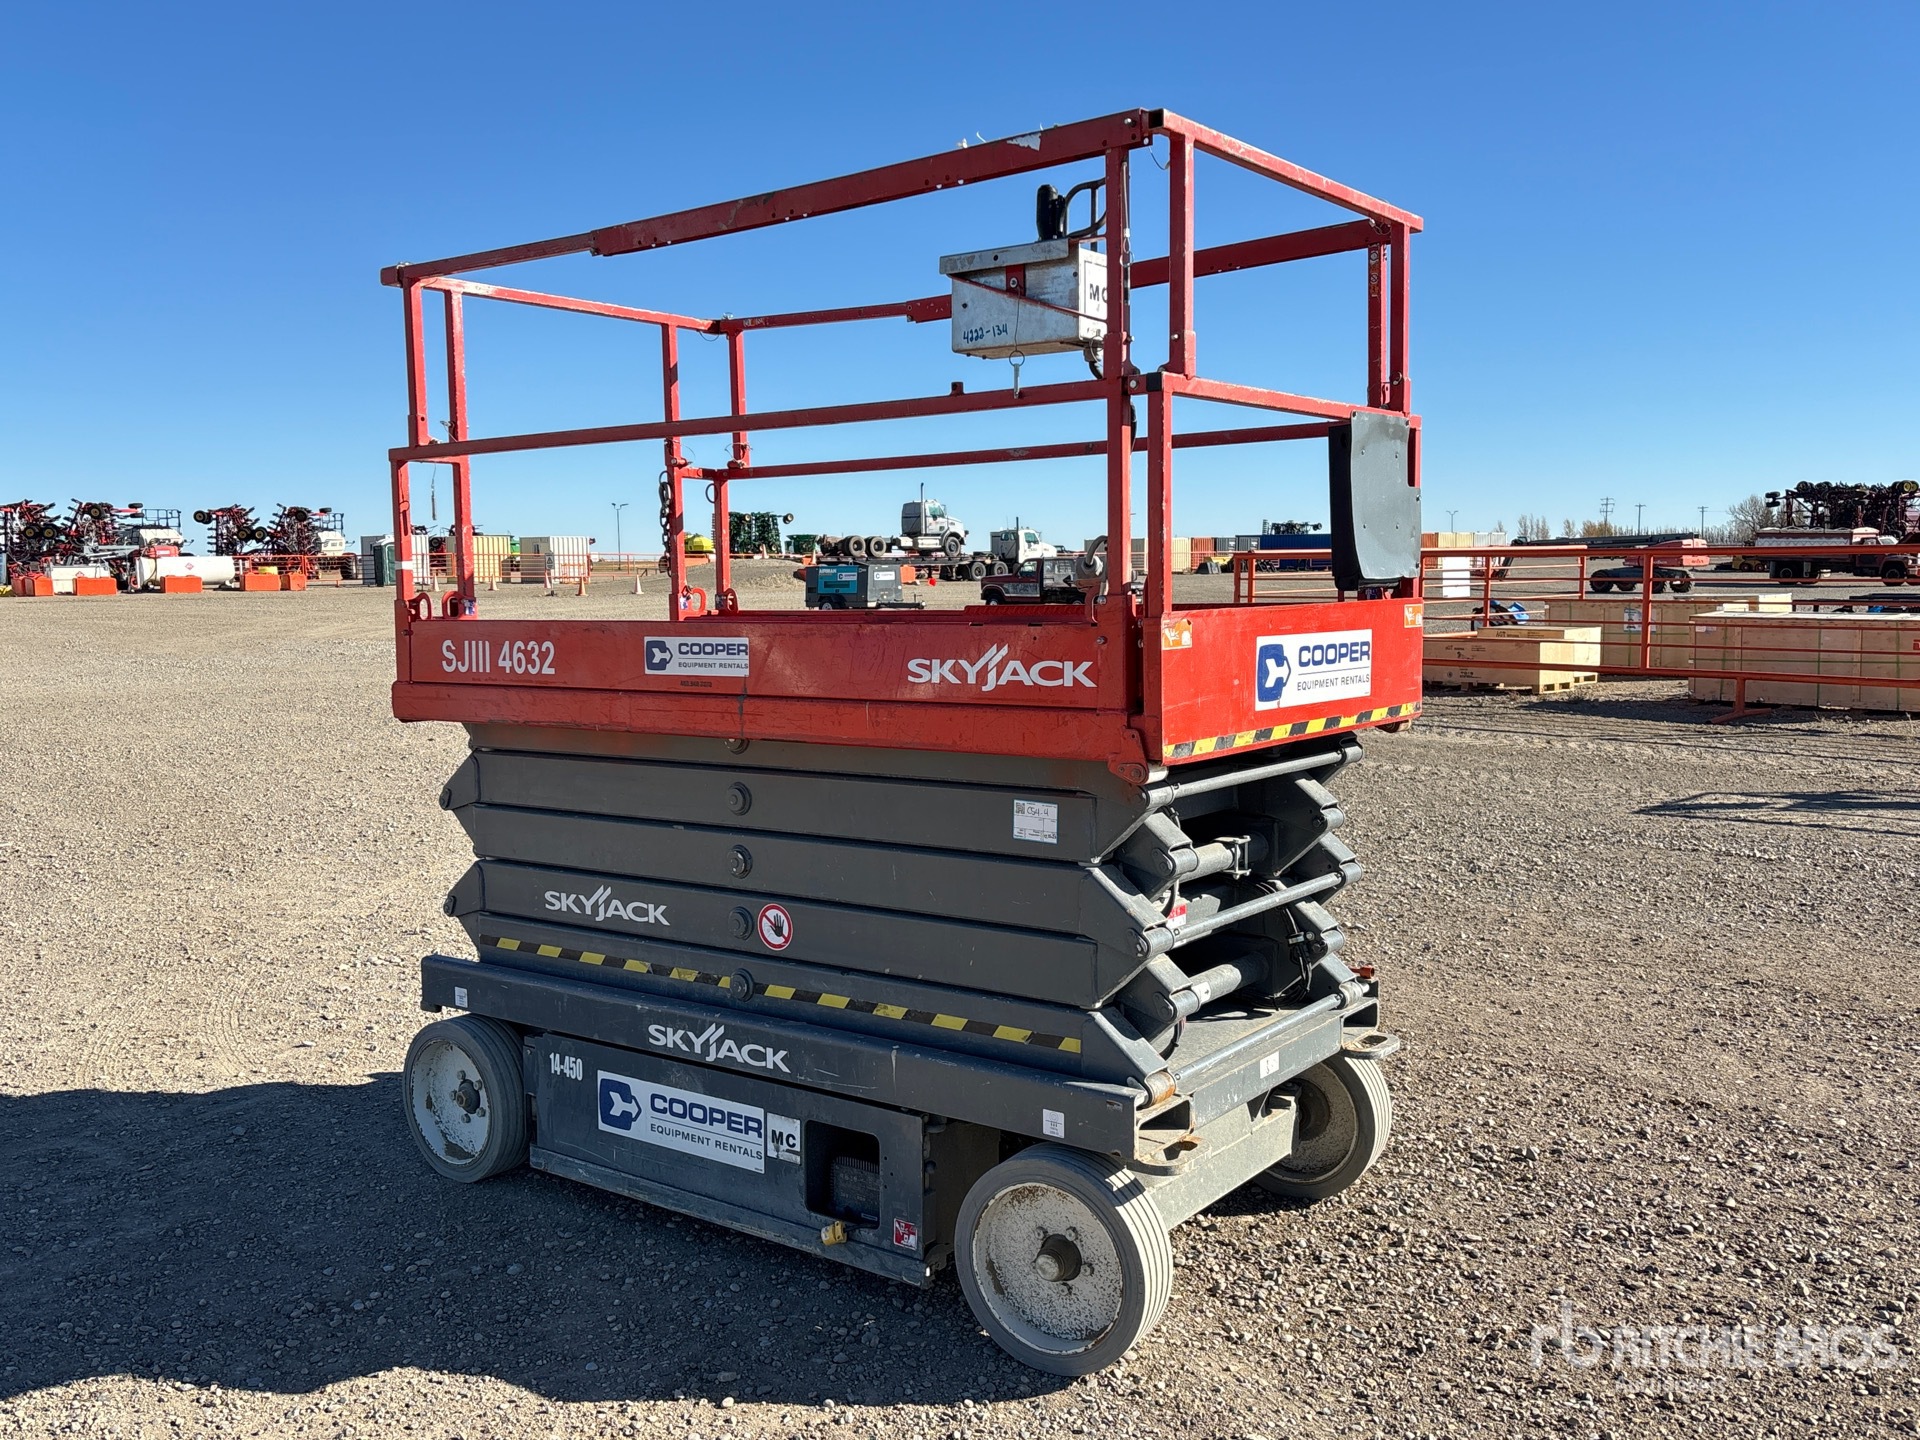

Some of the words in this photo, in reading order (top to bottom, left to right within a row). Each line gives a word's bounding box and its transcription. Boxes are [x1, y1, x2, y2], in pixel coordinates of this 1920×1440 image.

[963, 323, 1008, 344] 4222-134
[442, 639, 490, 672] SJIII
[498, 640, 555, 674] 4632
[678, 642, 748, 656] COOPER
[1298, 641, 1370, 667] COOPER
[678, 661, 717, 669] EQUIPMENT
[718, 662, 749, 670] RENTALS
[907, 643, 1098, 692] SKYJACK
[1297, 677, 1338, 691] EQUIPMENT
[1341, 673, 1370, 686] RENTALS
[544, 884, 670, 926] SKYJACK
[648, 1022, 791, 1073] SKYJACK
[549, 1052, 583, 1081] 14-450
[650, 1093, 763, 1138] COOPER
[650, 1123, 711, 1147] EQUIPMENT
[714, 1140, 763, 1161] RENTALS
[771, 1129, 797, 1149] MC
